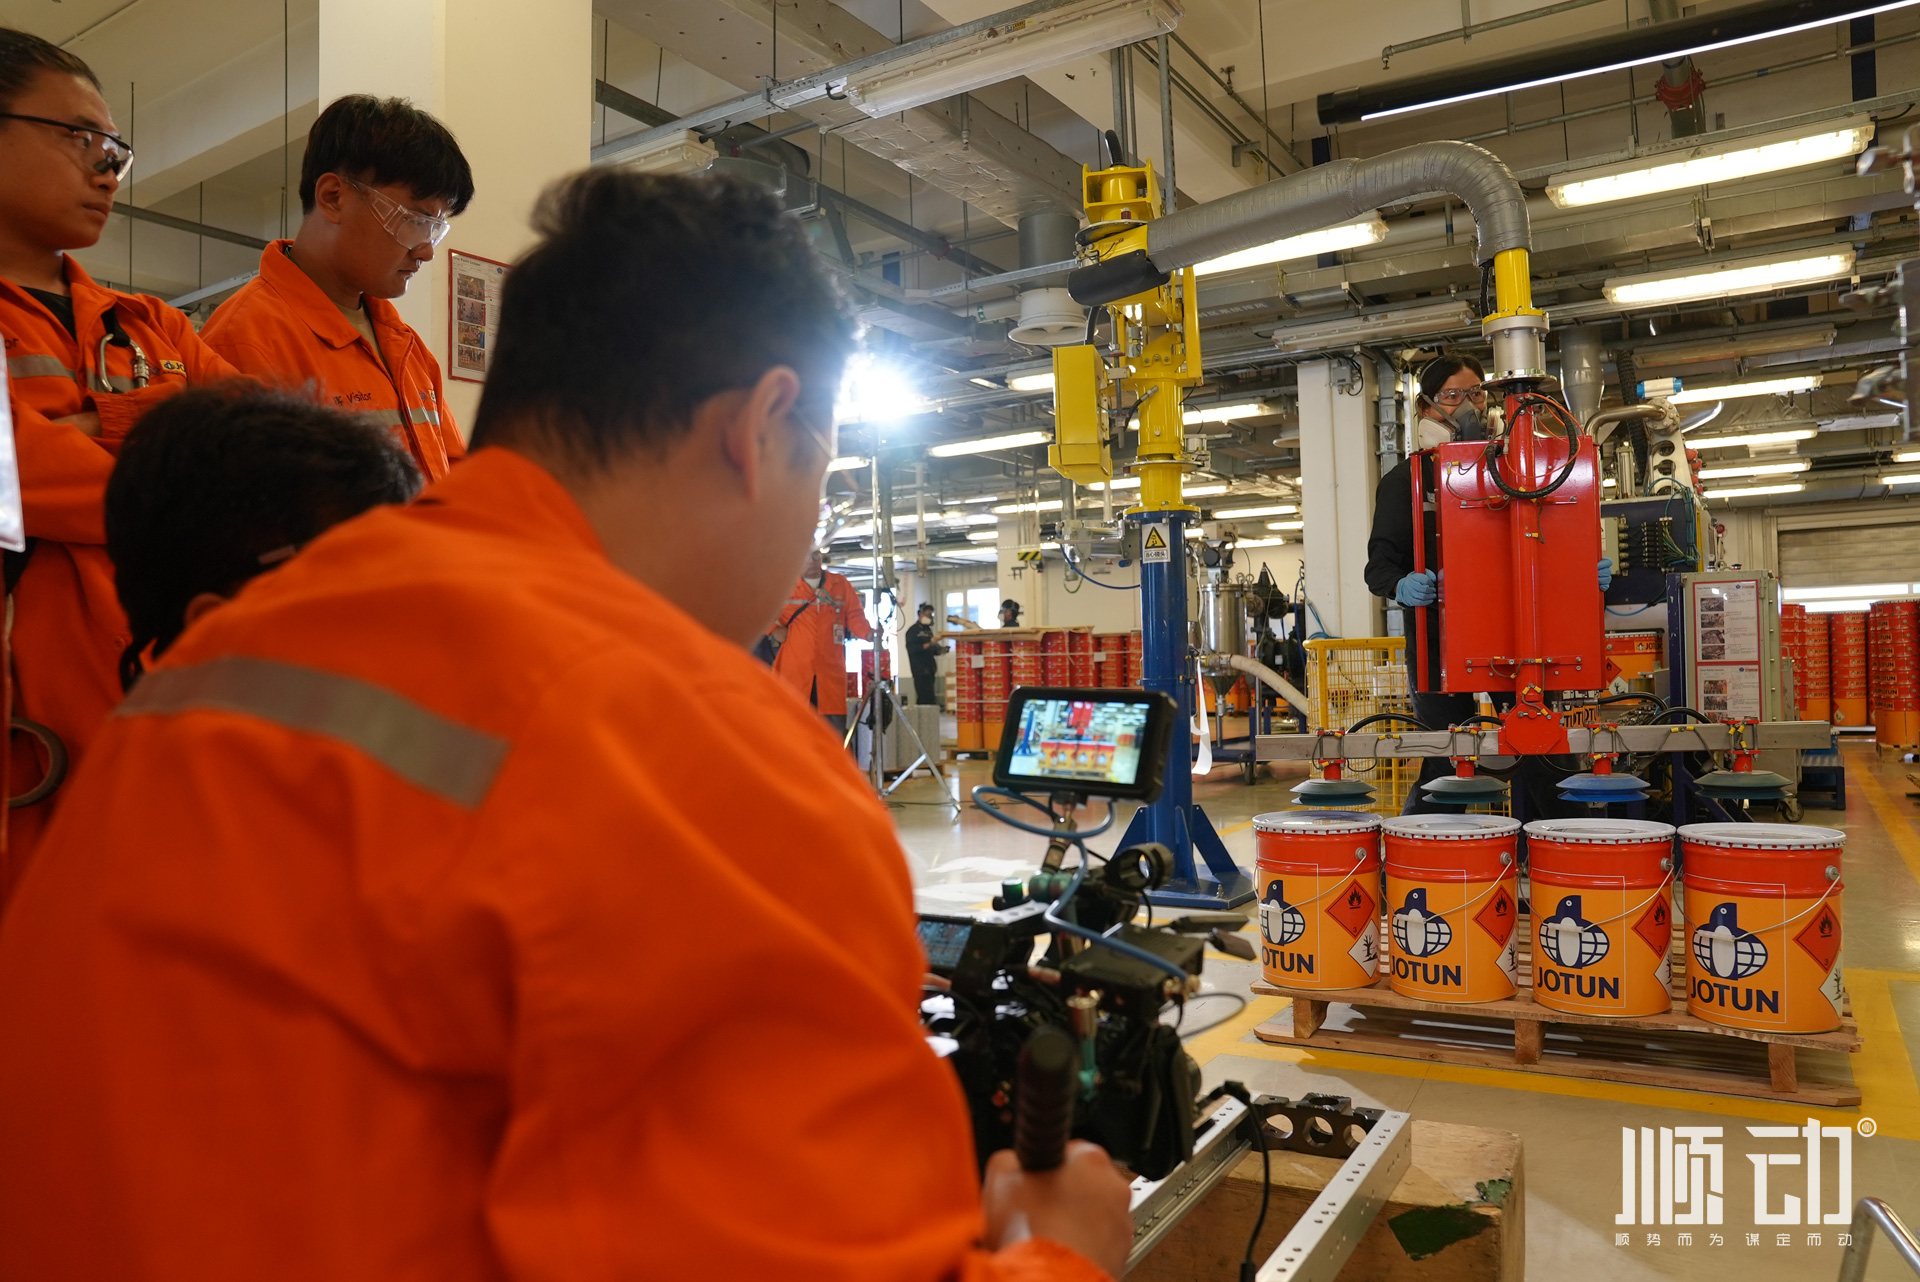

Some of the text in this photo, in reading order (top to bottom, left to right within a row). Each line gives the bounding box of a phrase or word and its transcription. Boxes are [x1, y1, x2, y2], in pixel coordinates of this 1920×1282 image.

[346, 391, 372, 404] Visitor
[1262, 946, 1314, 974] OTUN
[1392, 956, 1461, 986] JOTUN
[1538, 966, 1619, 999] JOTUN
[1691, 976, 1779, 1014] JOTUN
